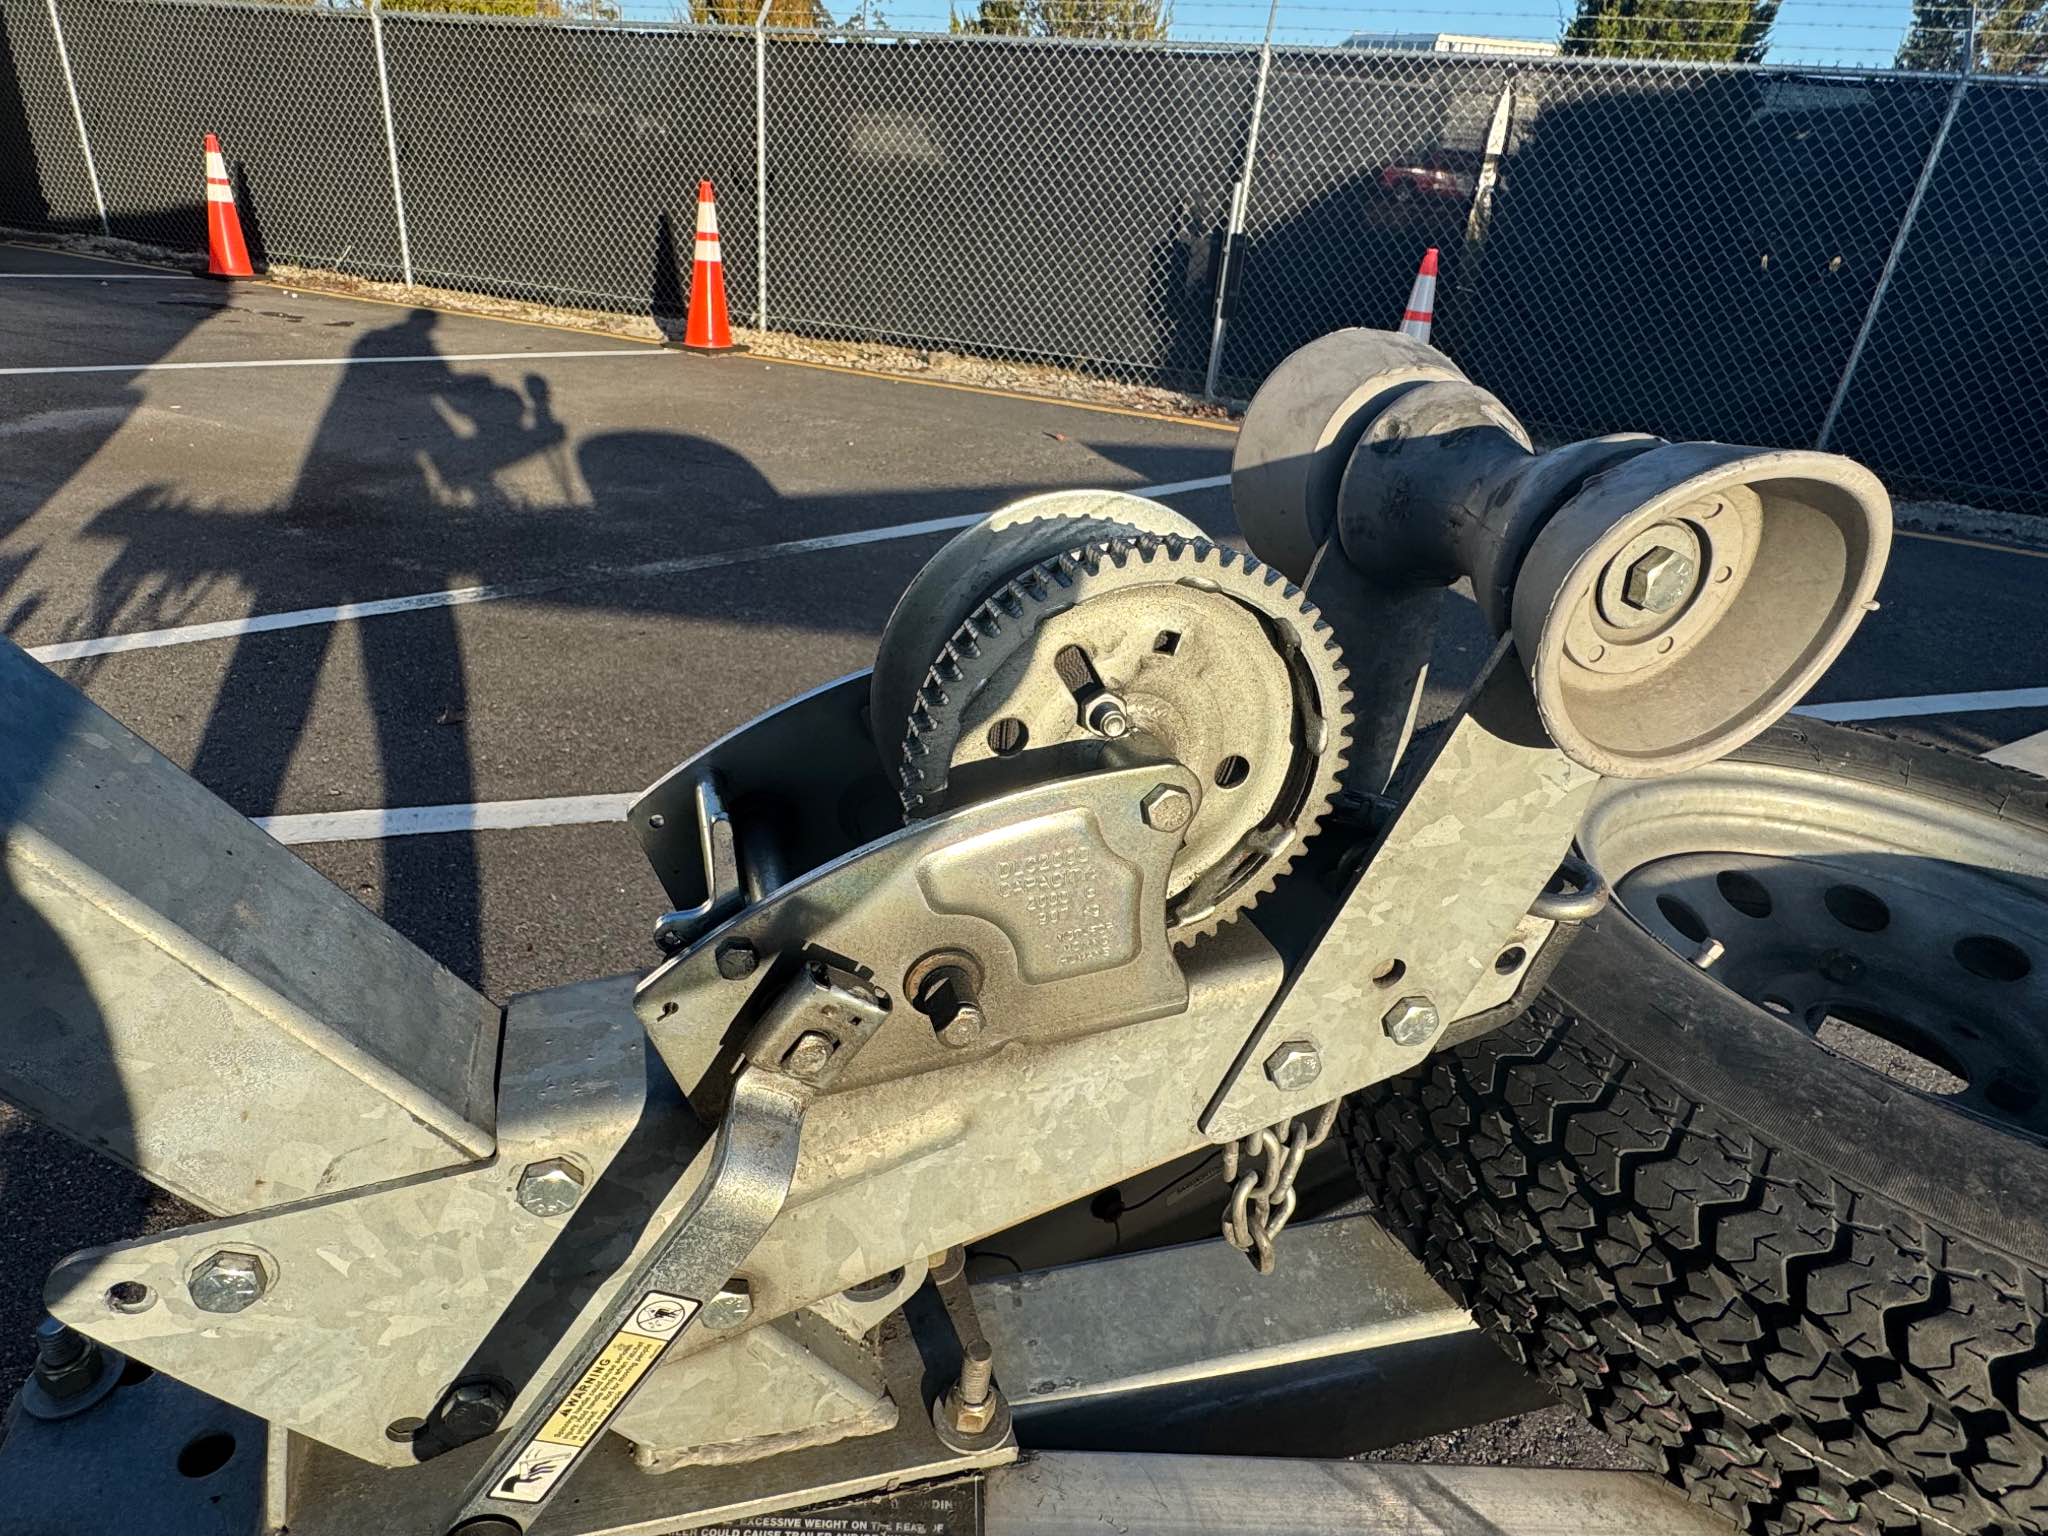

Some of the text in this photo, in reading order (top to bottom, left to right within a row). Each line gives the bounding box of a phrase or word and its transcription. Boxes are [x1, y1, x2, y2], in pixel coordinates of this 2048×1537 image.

[565, 1358, 610, 1406] WARNING
[804, 1518, 849, 1529] WEIGHT
[851, 1520, 868, 1530] ON
[701, 1528, 741, 1537] COULD
